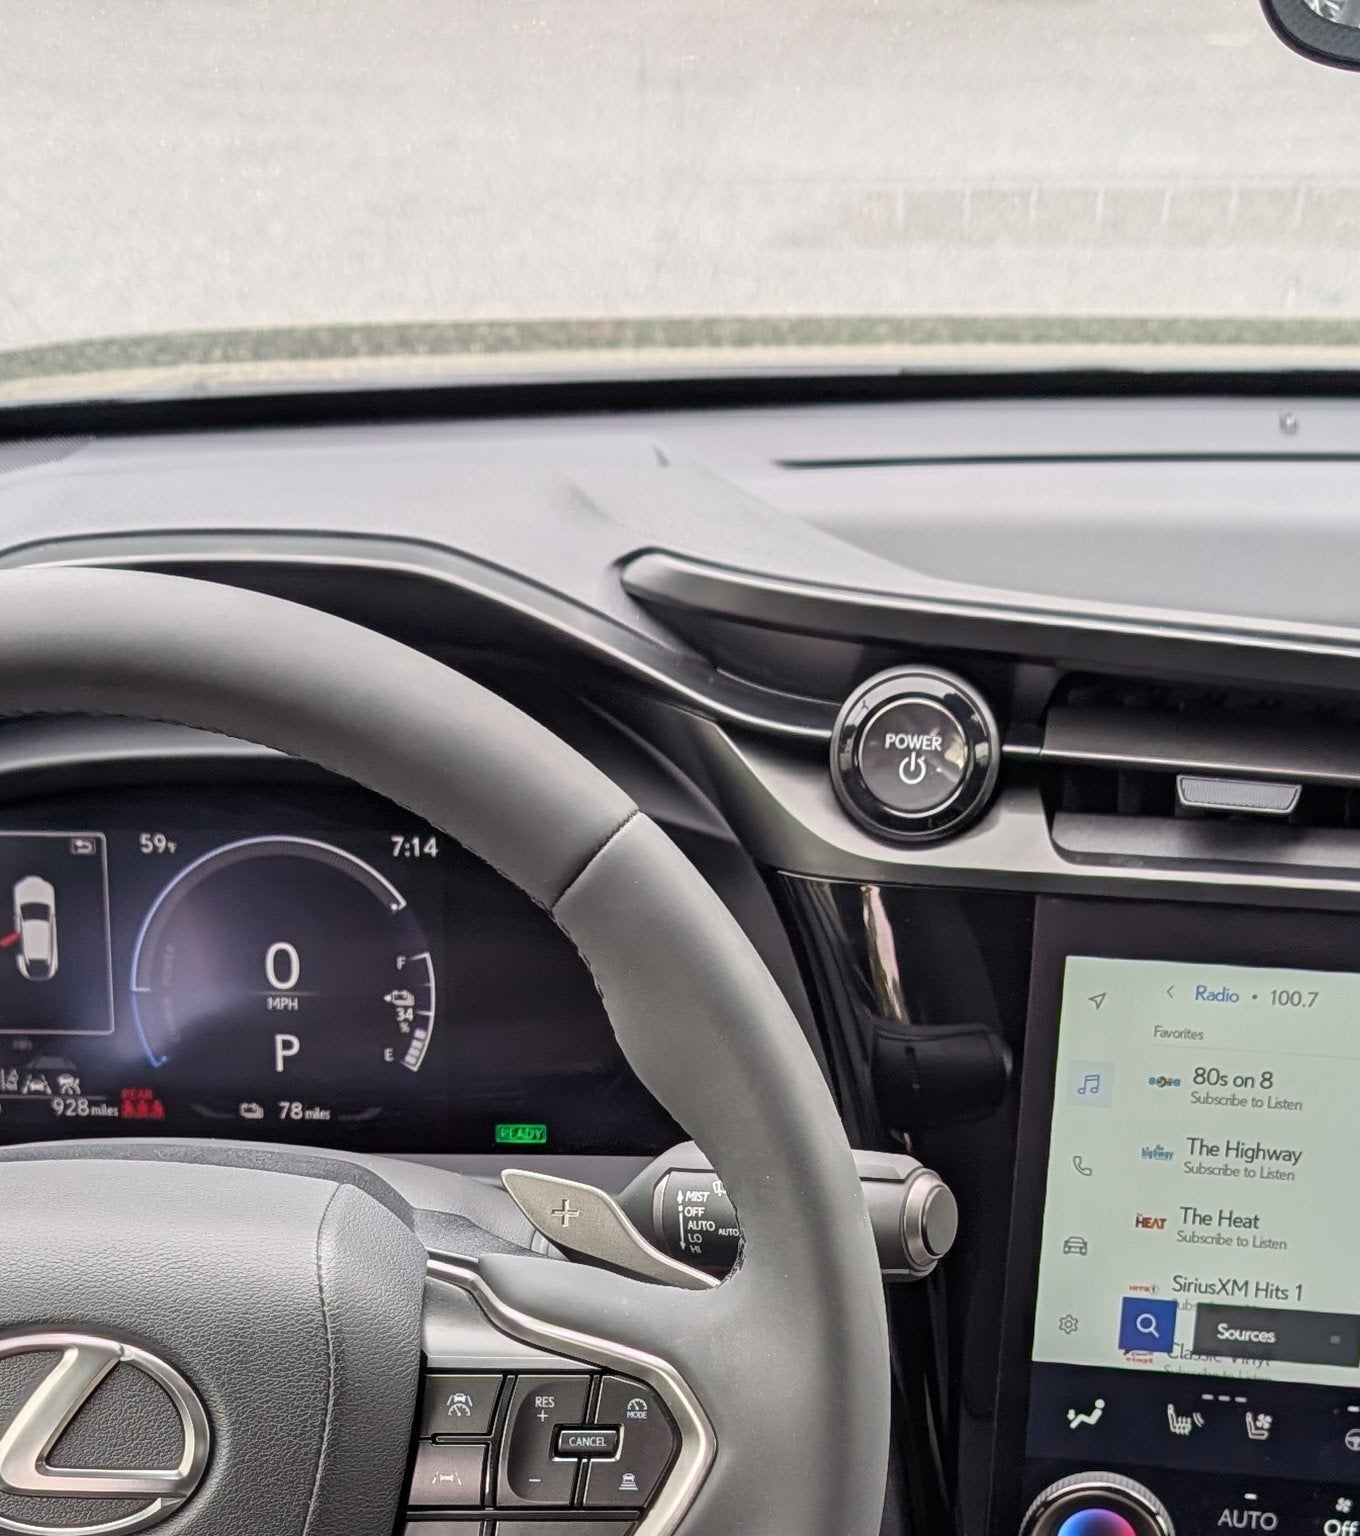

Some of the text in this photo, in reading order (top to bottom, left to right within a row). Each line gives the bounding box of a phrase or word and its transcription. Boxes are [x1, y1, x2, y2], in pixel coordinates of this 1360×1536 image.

[885, 733, 942, 751] POWER
[390, 836, 438, 857] 7:14
[265, 942, 300, 990] 0
[397, 957, 406, 970] F
[268, 997, 299, 1012] MPH
[1194, 985, 1319, 1009] Radio 100.7
[396, 1007, 414, 1022] 34
[1152, 1024, 1205, 1042] Favorites
[275, 1034, 300, 1072] P
[384, 1048, 394, 1062] E
[1192, 1066, 1228, 1088] 80s
[1233, 1074, 1254, 1089] on
[1259, 1070, 1274, 1090] 8
[51, 1097, 119, 1117] 928 miles
[1189, 1091, 1303, 1111] Subscribe to Listen
[279, 1102, 331, 1120] 78 miles
[1186, 1137, 1303, 1166] The Highway
[1182, 1162, 1296, 1182] Subscribe to Listen
[685, 1191, 710, 1202] MIST
[684, 1206, 706, 1217] OFF
[1179, 1206, 1260, 1230] The Heat
[687, 1220, 716, 1231] AUTO
[1135, 1215, 1167, 1230] HEAT
[688, 1233, 703, 1244] LO
[718, 1228, 739, 1237] AUTO
[1176, 1231, 1288, 1251] Subscribe to Listen
[1172, 1275, 1248, 1297] SiriusXM
[1254, 1280, 1290, 1300] Hits
[1294, 1283, 1303, 1301] 1
[1216, 1323, 1276, 1343] Sources
[535, 1396, 555, 1409] RES
[627, 1409, 648, 1420] MODE
[568, 1435, 608, 1448] CANCEL
[1218, 1507, 1279, 1532] AUTO
